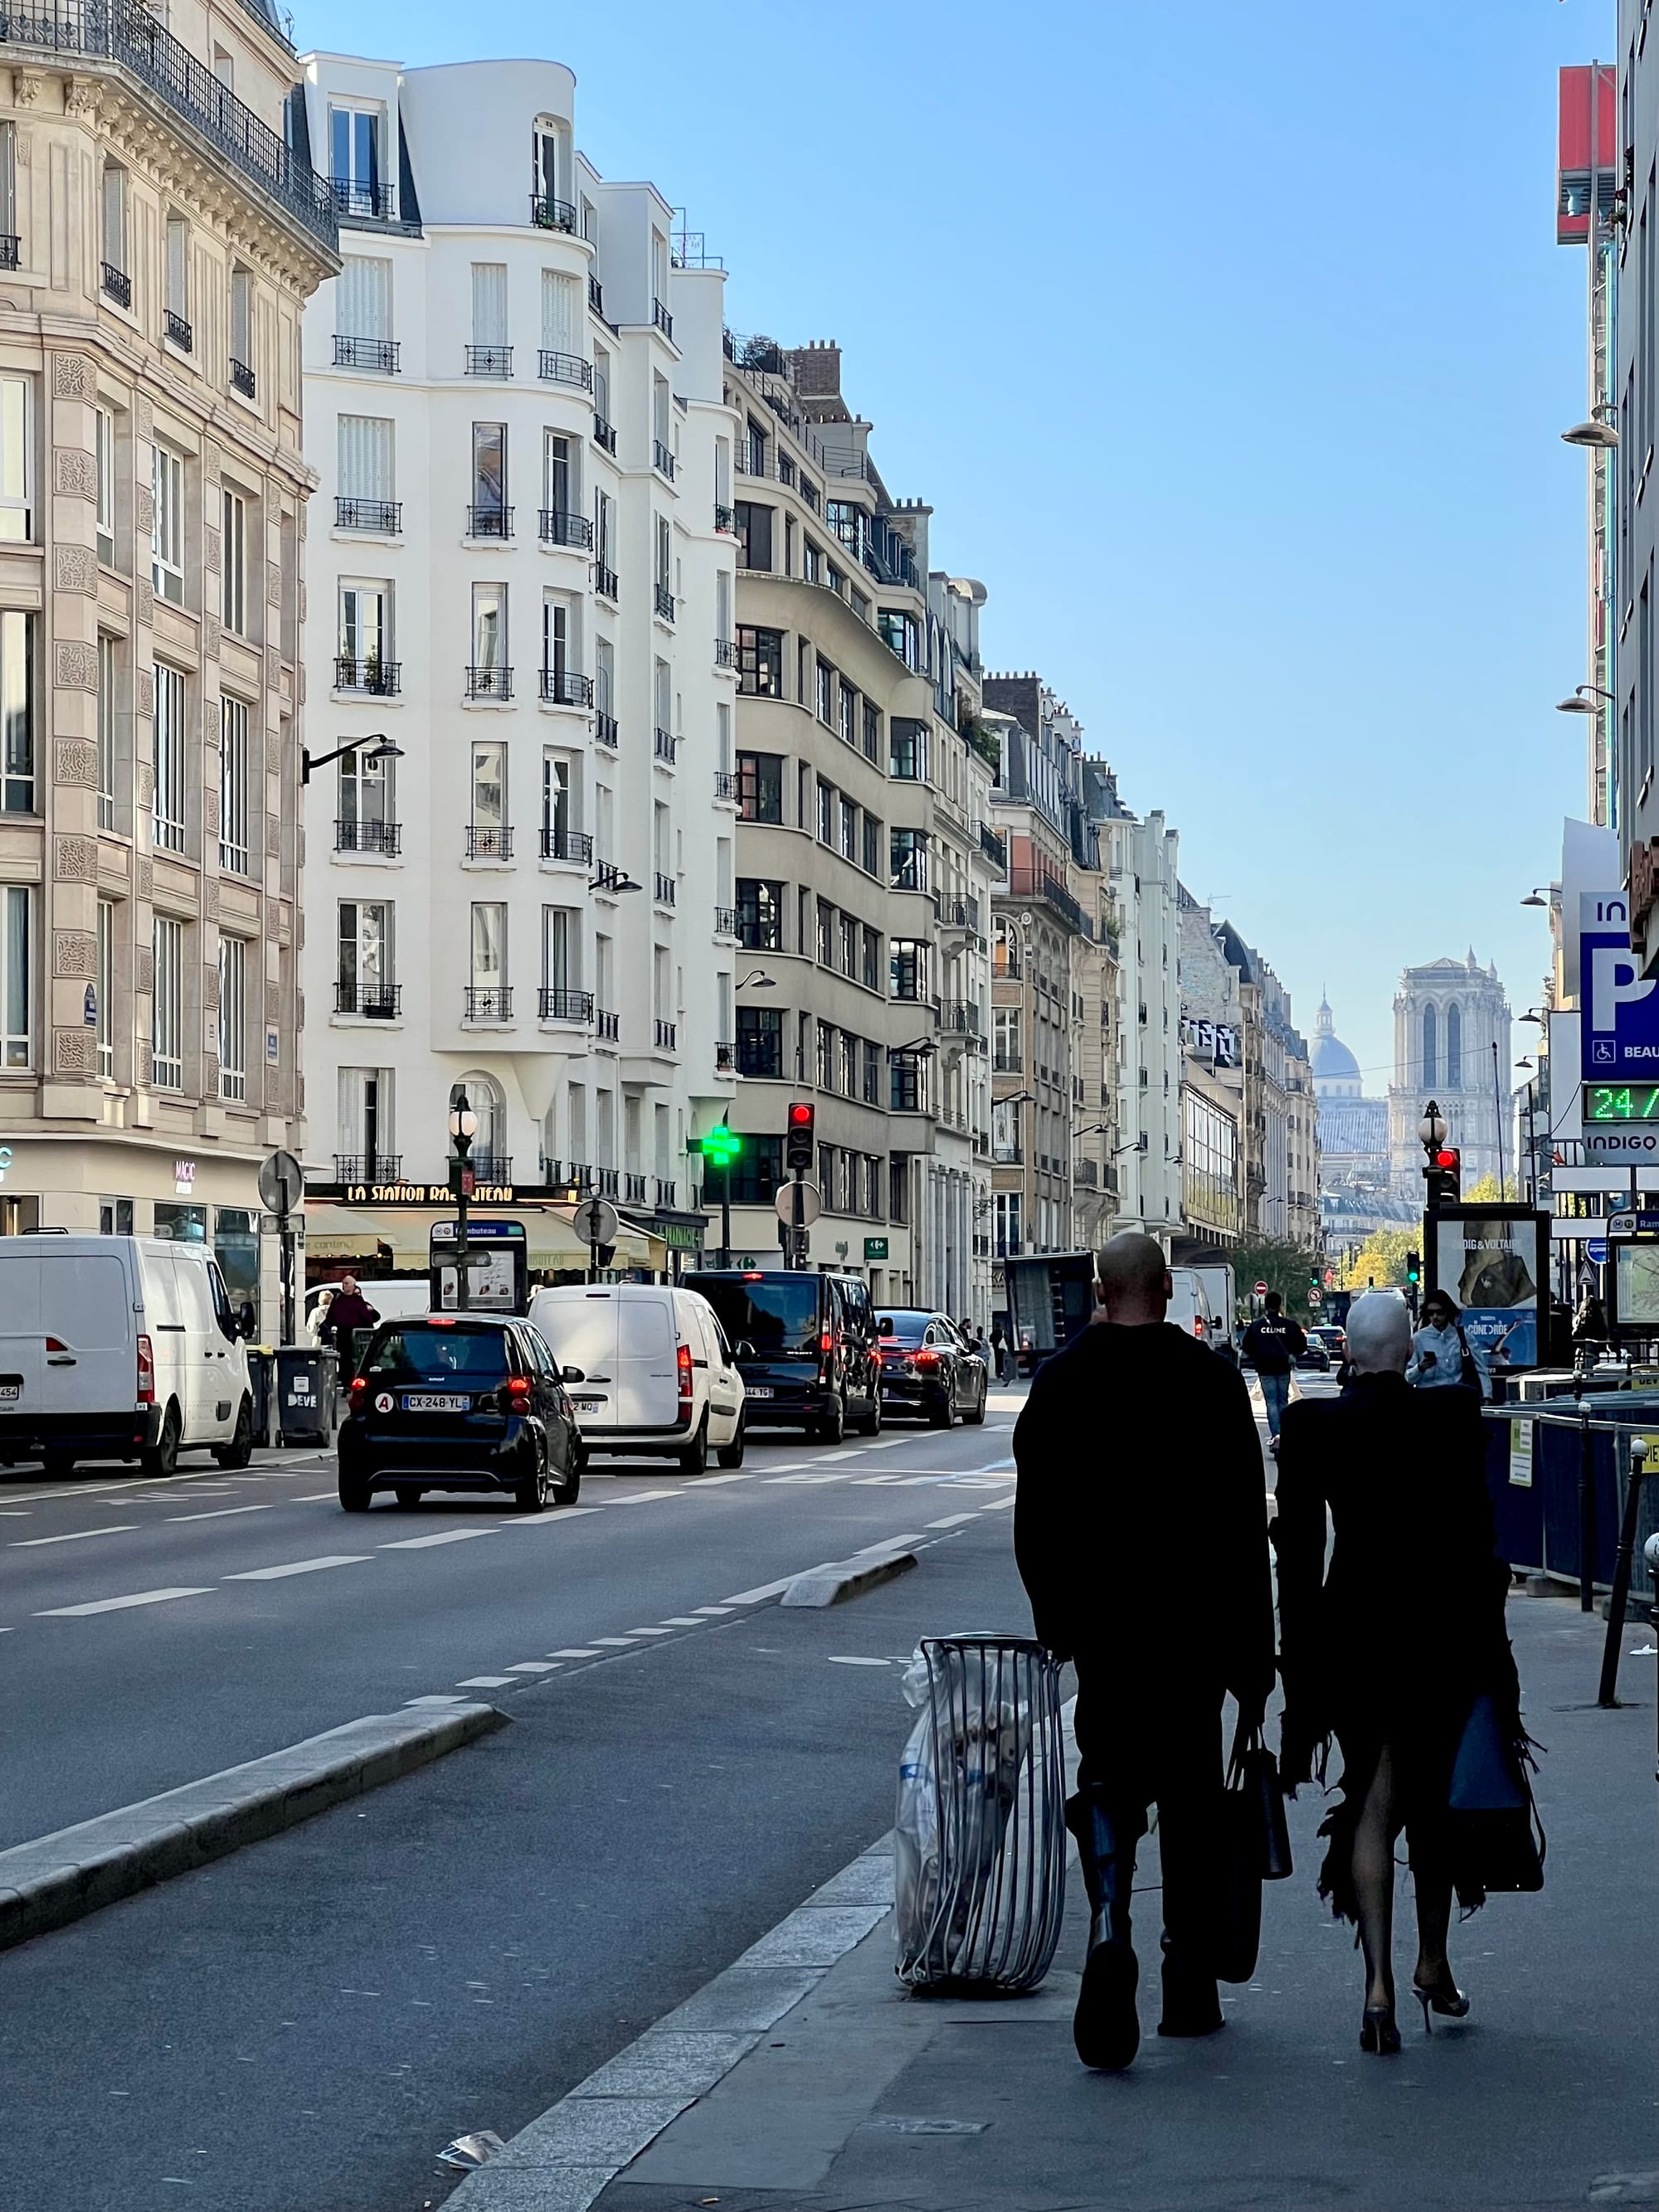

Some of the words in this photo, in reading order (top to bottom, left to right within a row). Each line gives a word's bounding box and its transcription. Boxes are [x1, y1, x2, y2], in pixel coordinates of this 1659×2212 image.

[1592, 948, 1657, 1032] P
[1587, 1135, 1657, 1150] INDIGO
[175, 1160, 196, 1181] MAGIC
[348, 1186, 366, 1201] LA
[372, 1186, 424, 1201] STATION
[378, 1397, 388, 1409] A
[409, 1396, 462, 1408] CX-248-YL
